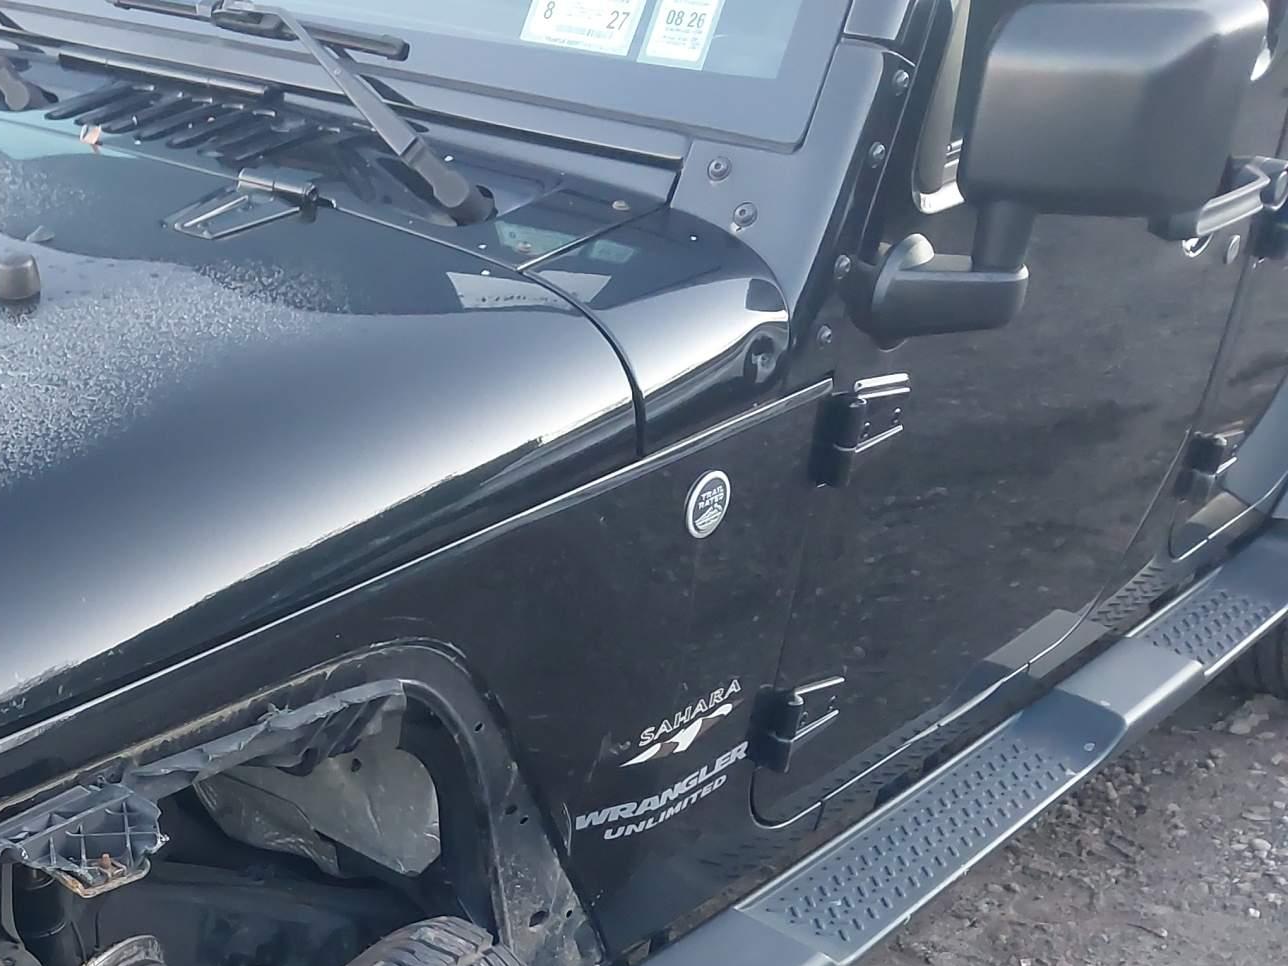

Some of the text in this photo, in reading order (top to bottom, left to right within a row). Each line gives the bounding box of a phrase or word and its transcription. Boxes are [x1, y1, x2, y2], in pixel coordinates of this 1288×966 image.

[543, 0, 556, 20] 8
[606, 9, 630, 31] 27
[665, 9, 707, 29] 08 26
[638, 679, 741, 747] SAHARA
[575, 741, 749, 830] WRANGLER
[603, 774, 727, 840] UNLIMITED
